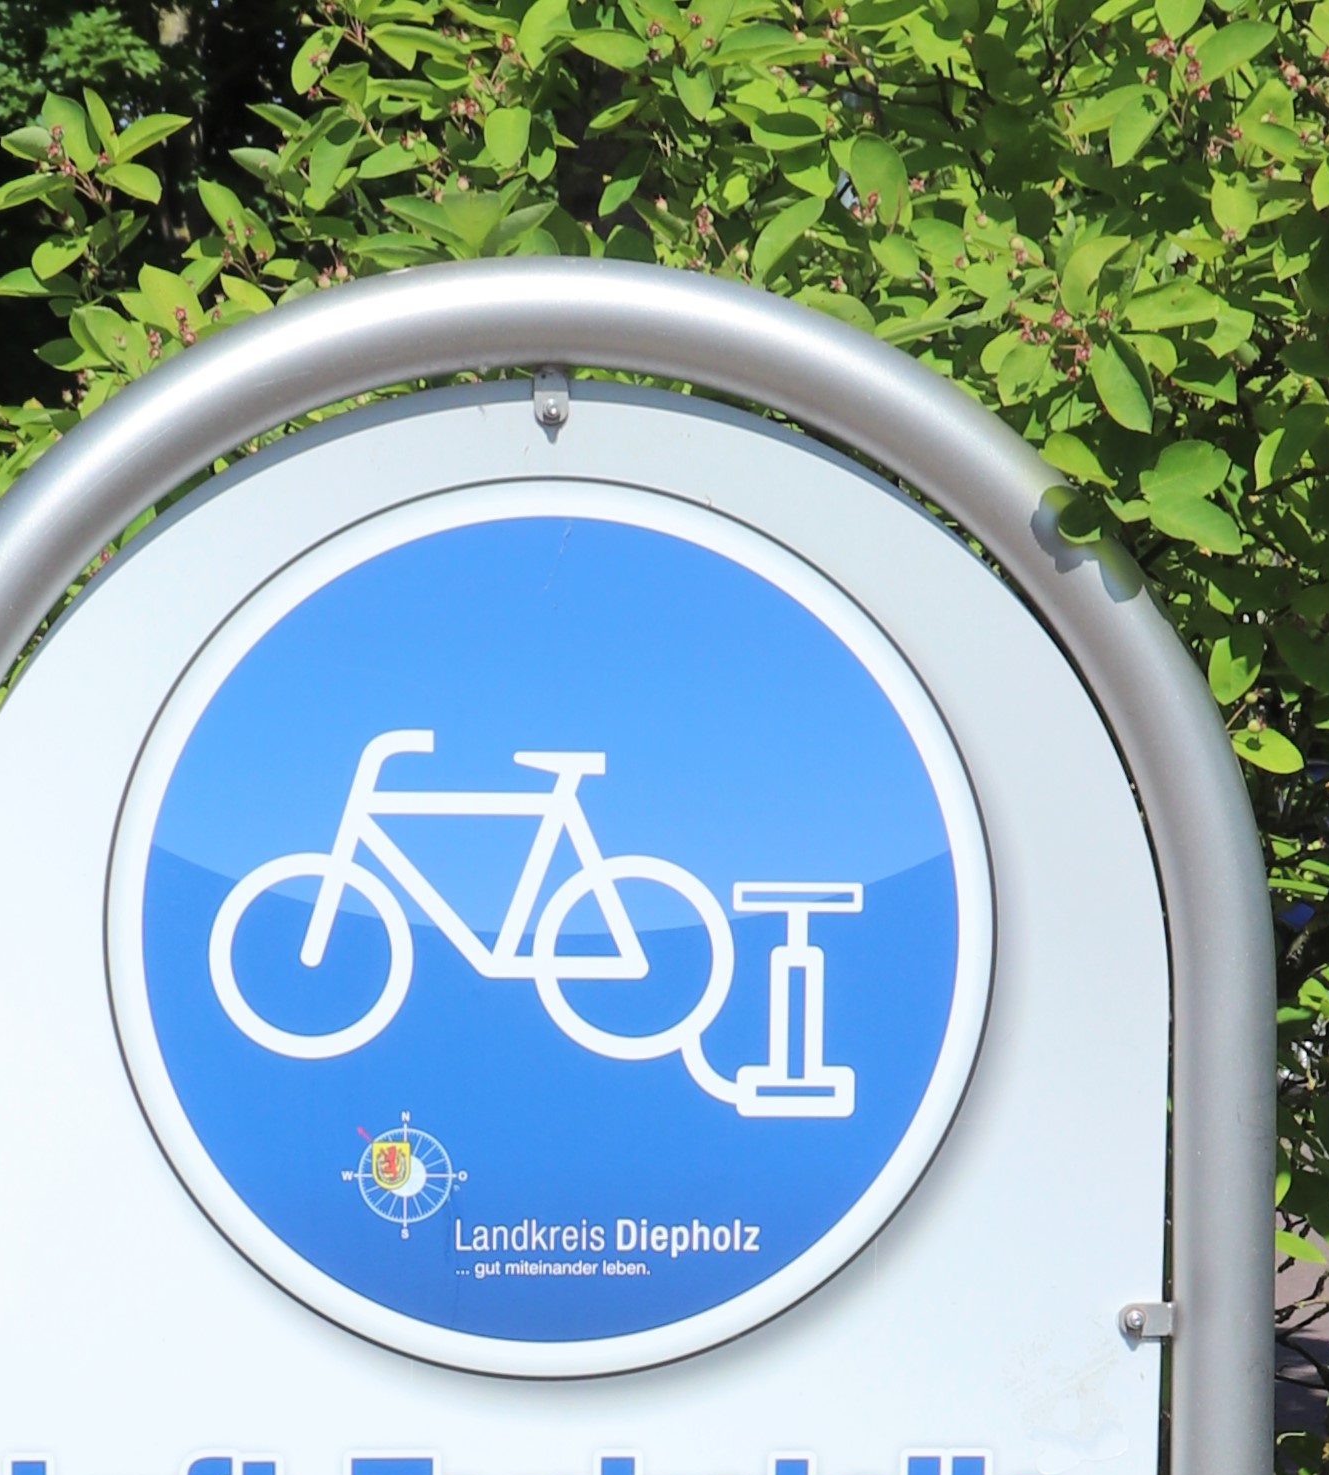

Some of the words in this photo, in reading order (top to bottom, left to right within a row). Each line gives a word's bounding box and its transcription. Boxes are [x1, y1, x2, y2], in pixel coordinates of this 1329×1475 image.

[401, 1111, 411, 1122] N
[341, 1170, 354, 1181] W
[401, 1228, 410, 1240] S
[455, 1218, 605, 1251] Landkreis
[616, 1218, 760, 1257] Diepholz
[474, 1262, 501, 1279] gut
[505, 1260, 599, 1276] miteinander
[603, 1260, 651, 1276] leben.
